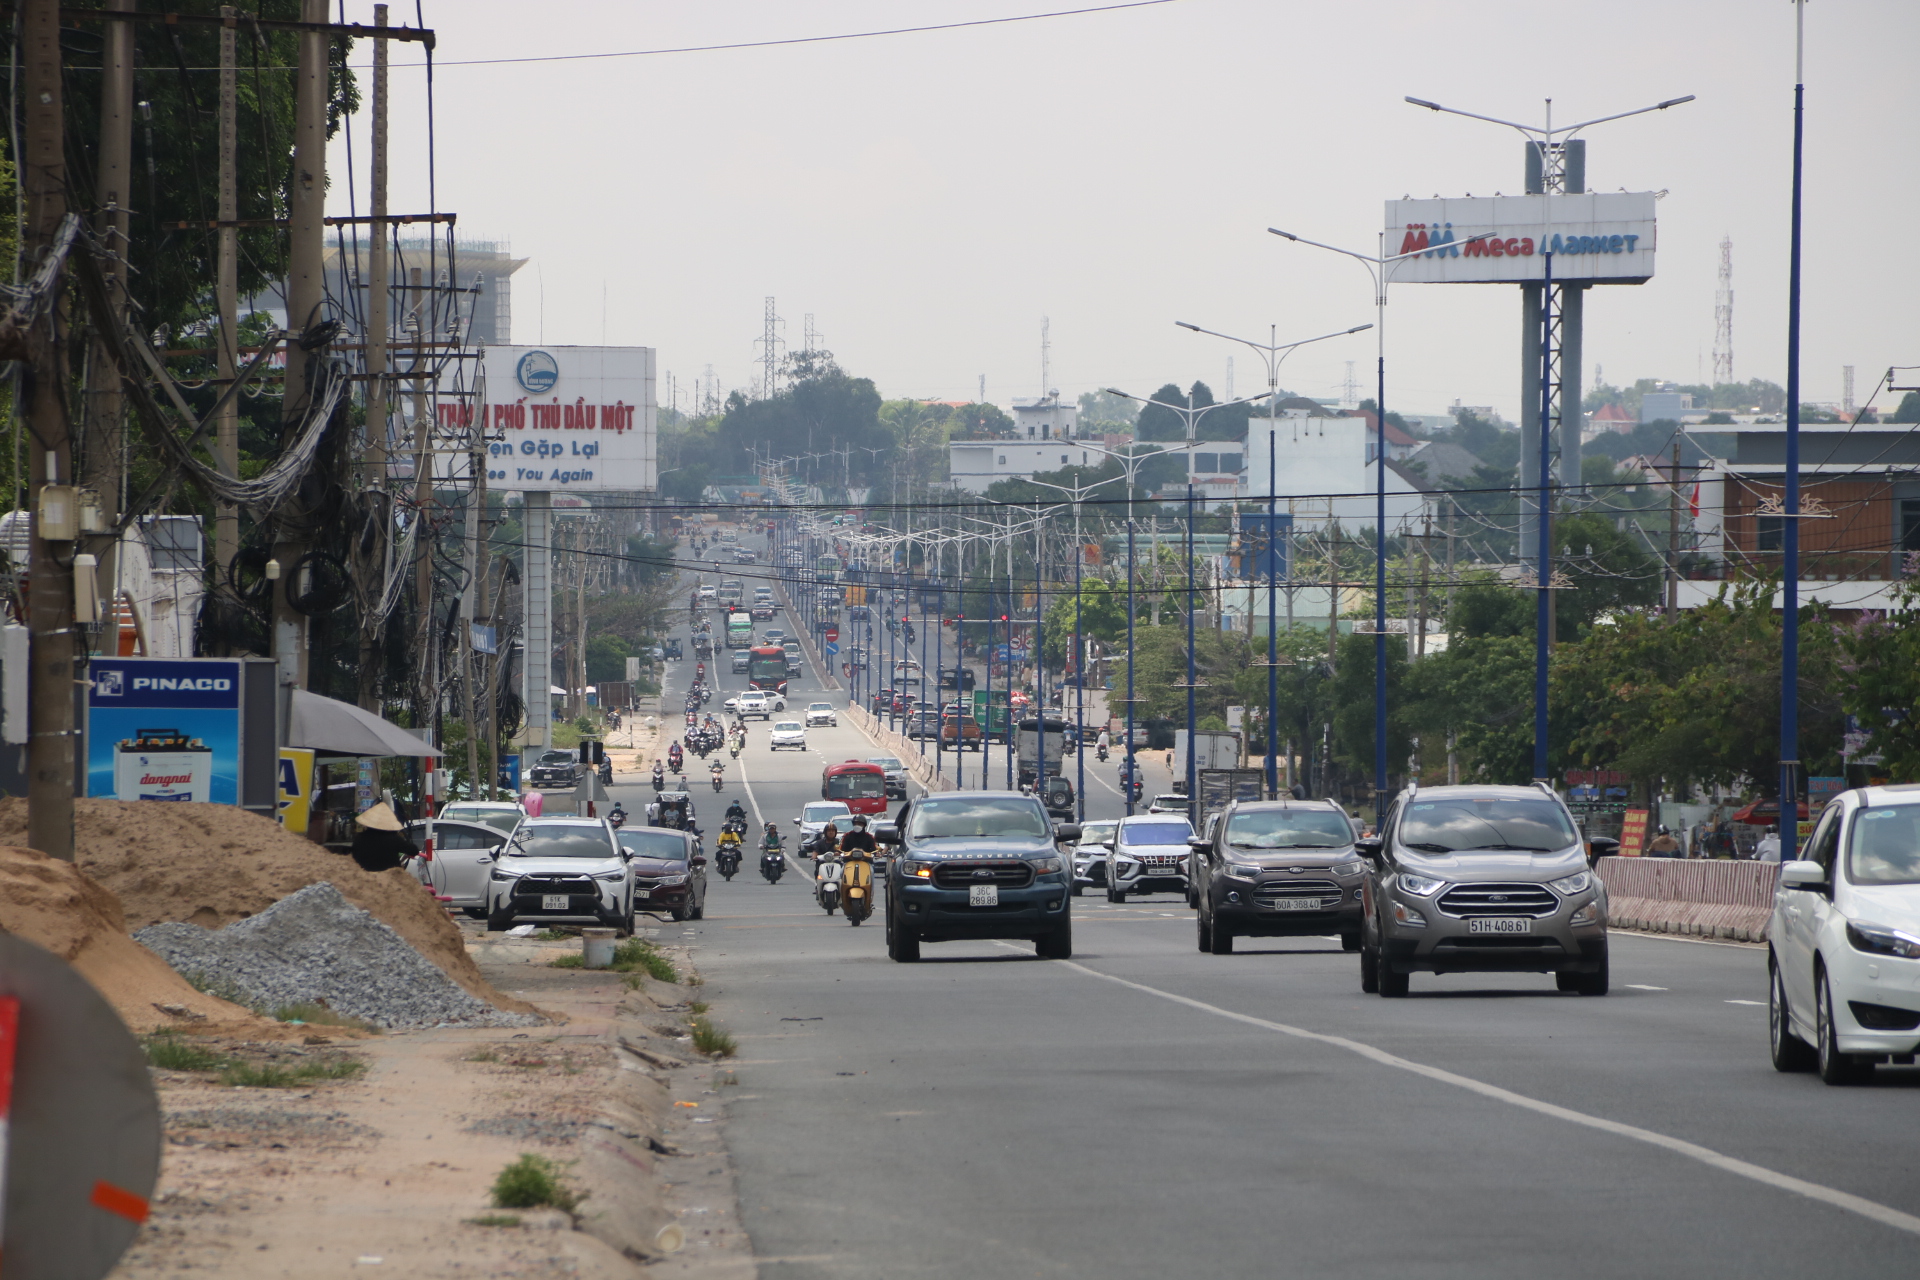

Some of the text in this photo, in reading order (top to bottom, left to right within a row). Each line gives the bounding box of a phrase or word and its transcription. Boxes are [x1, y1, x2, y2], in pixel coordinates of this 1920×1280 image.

[494, 396, 529, 430] PHỐ
[530, 396, 561, 430] THỦ
[564, 396, 596, 430] DẦU
[601, 400, 635, 435] MỘT
[489, 439, 599, 460] ẹn Gặp Lại
[486, 468, 594, 484] ee You Again
[133, 677, 231, 691] PINACO
[976, 886, 991, 896] 36C
[970, 896, 997, 906] 289.86
[1471, 920, 1528, 932] 51H-408.61
